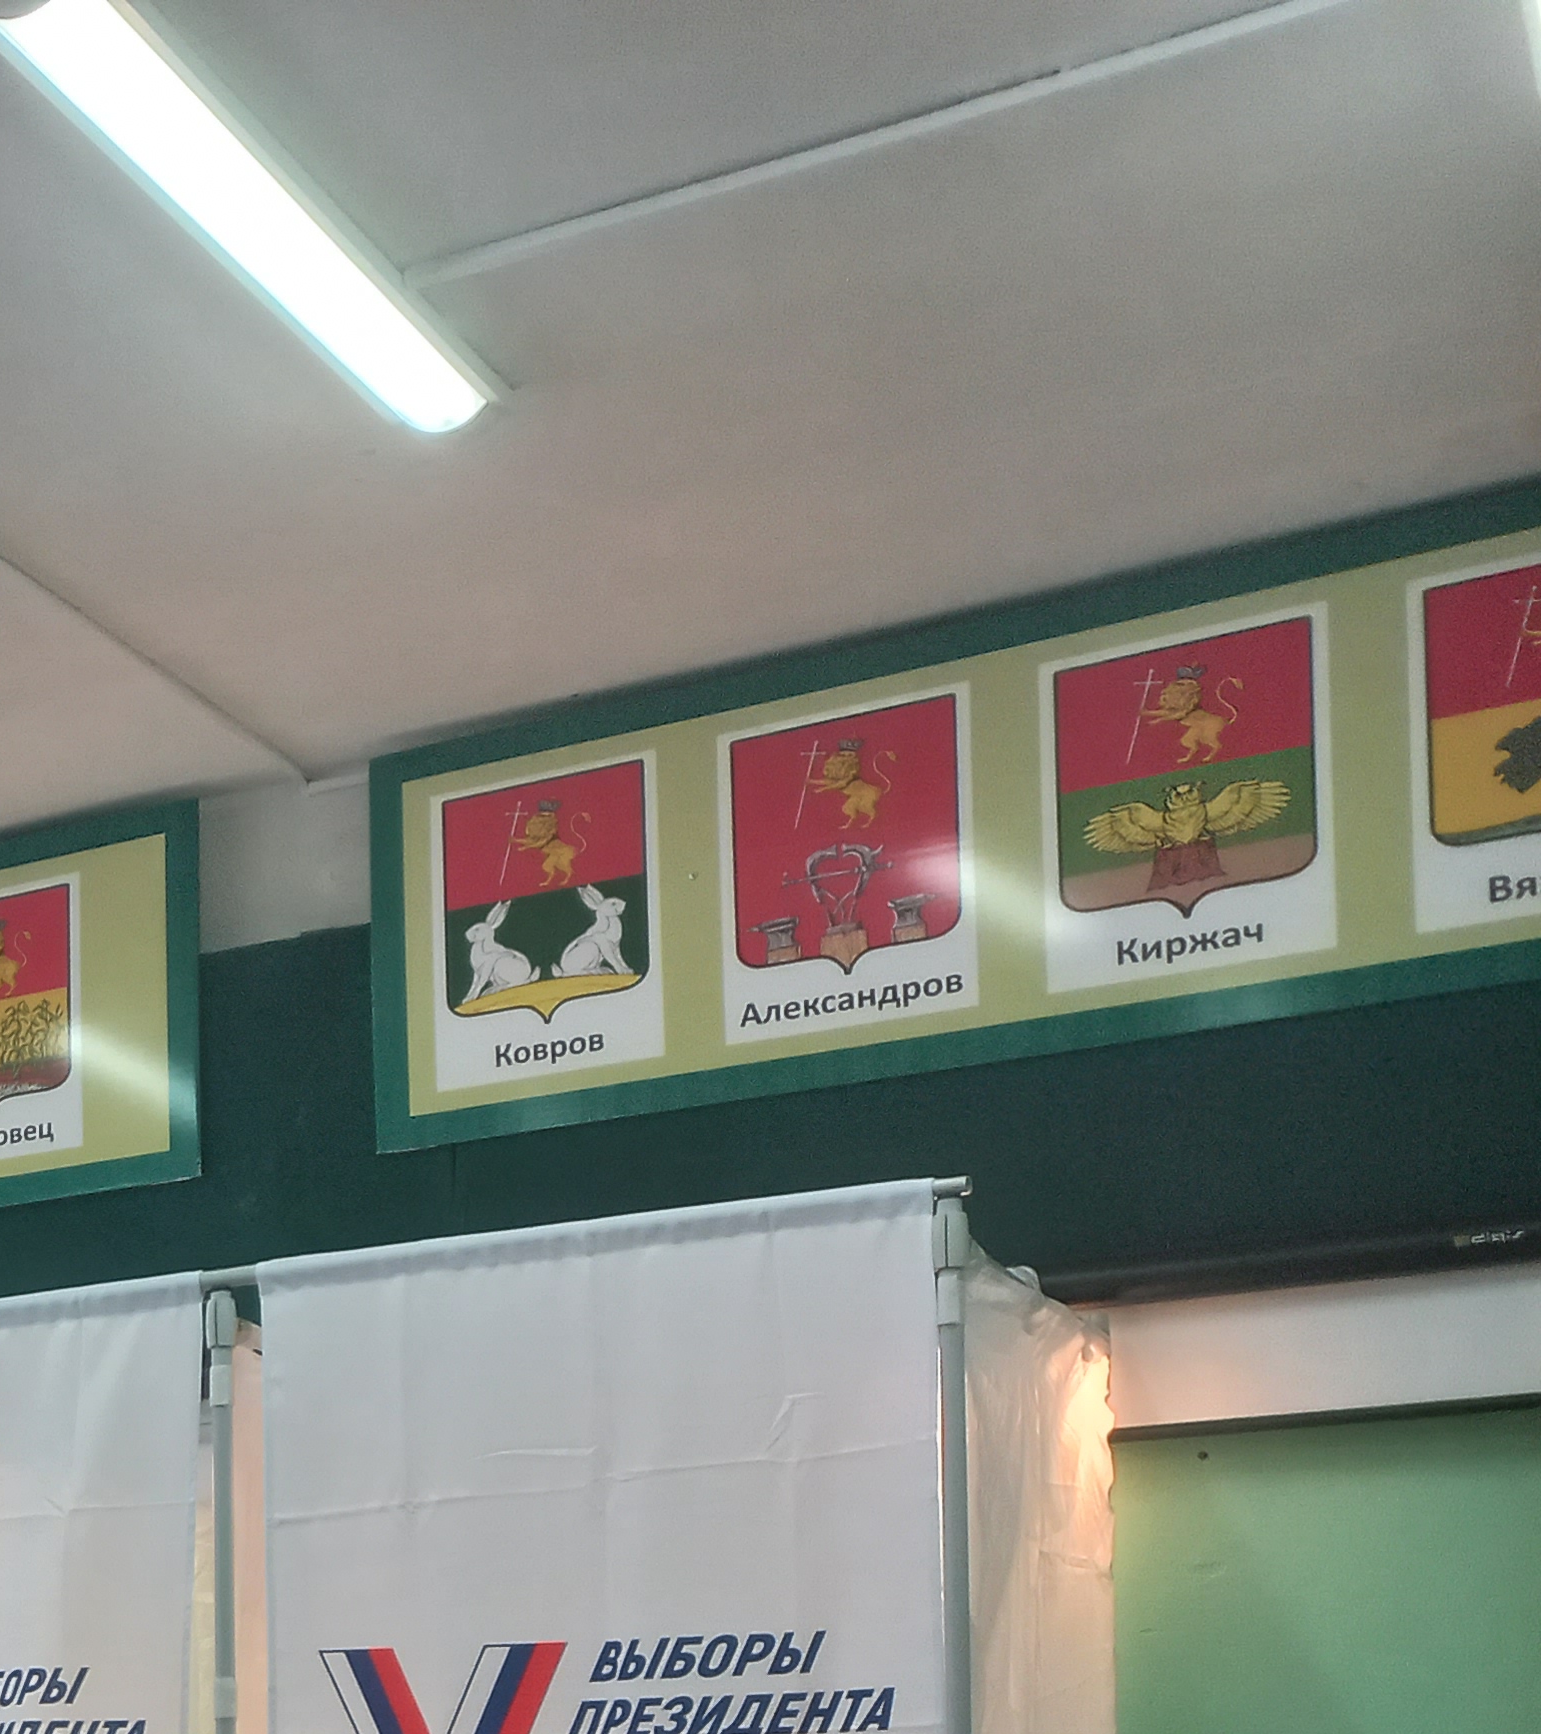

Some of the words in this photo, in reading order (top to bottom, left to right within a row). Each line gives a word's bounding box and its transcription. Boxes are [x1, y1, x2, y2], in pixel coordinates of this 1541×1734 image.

[1489, 876, 1537, 904] Вя
[1114, 917, 1264, 967] Киржач
[739, 967, 965, 1030] Александров
[493, 1029, 605, 1069] Ковров
[588, 1630, 827, 1683] ВЫБОРЫ
